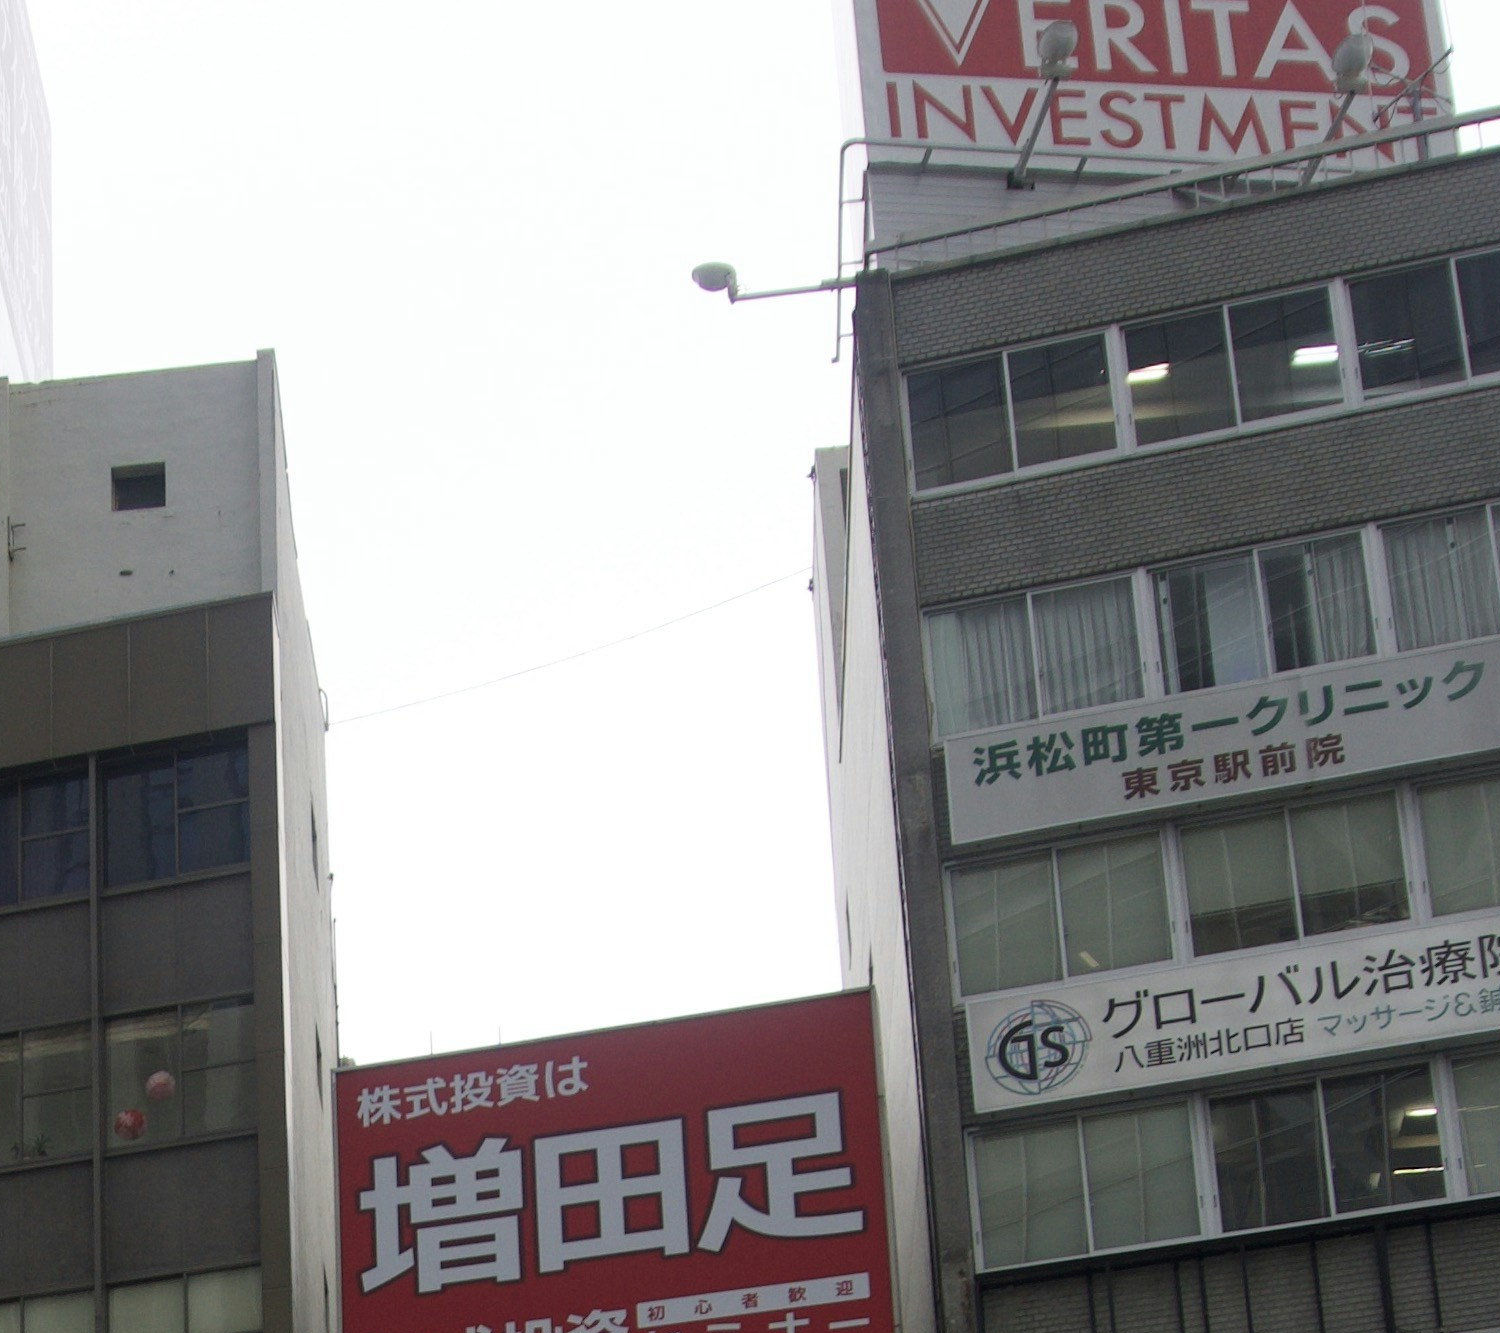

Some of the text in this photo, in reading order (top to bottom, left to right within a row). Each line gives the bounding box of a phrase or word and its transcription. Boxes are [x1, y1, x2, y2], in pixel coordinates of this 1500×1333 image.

[972, 659, 1486, 787] 浜松町第一クリニック
[1121, 732, 1346, 800] 東京駅前院
[1114, 1018, 1305, 1073] 八重洲北口店
[357, 1056, 589, 1128] 株式投資は
[357, 1090, 866, 1295] 増田足
[647, 1279, 855, 1322] 初心者歓迎
